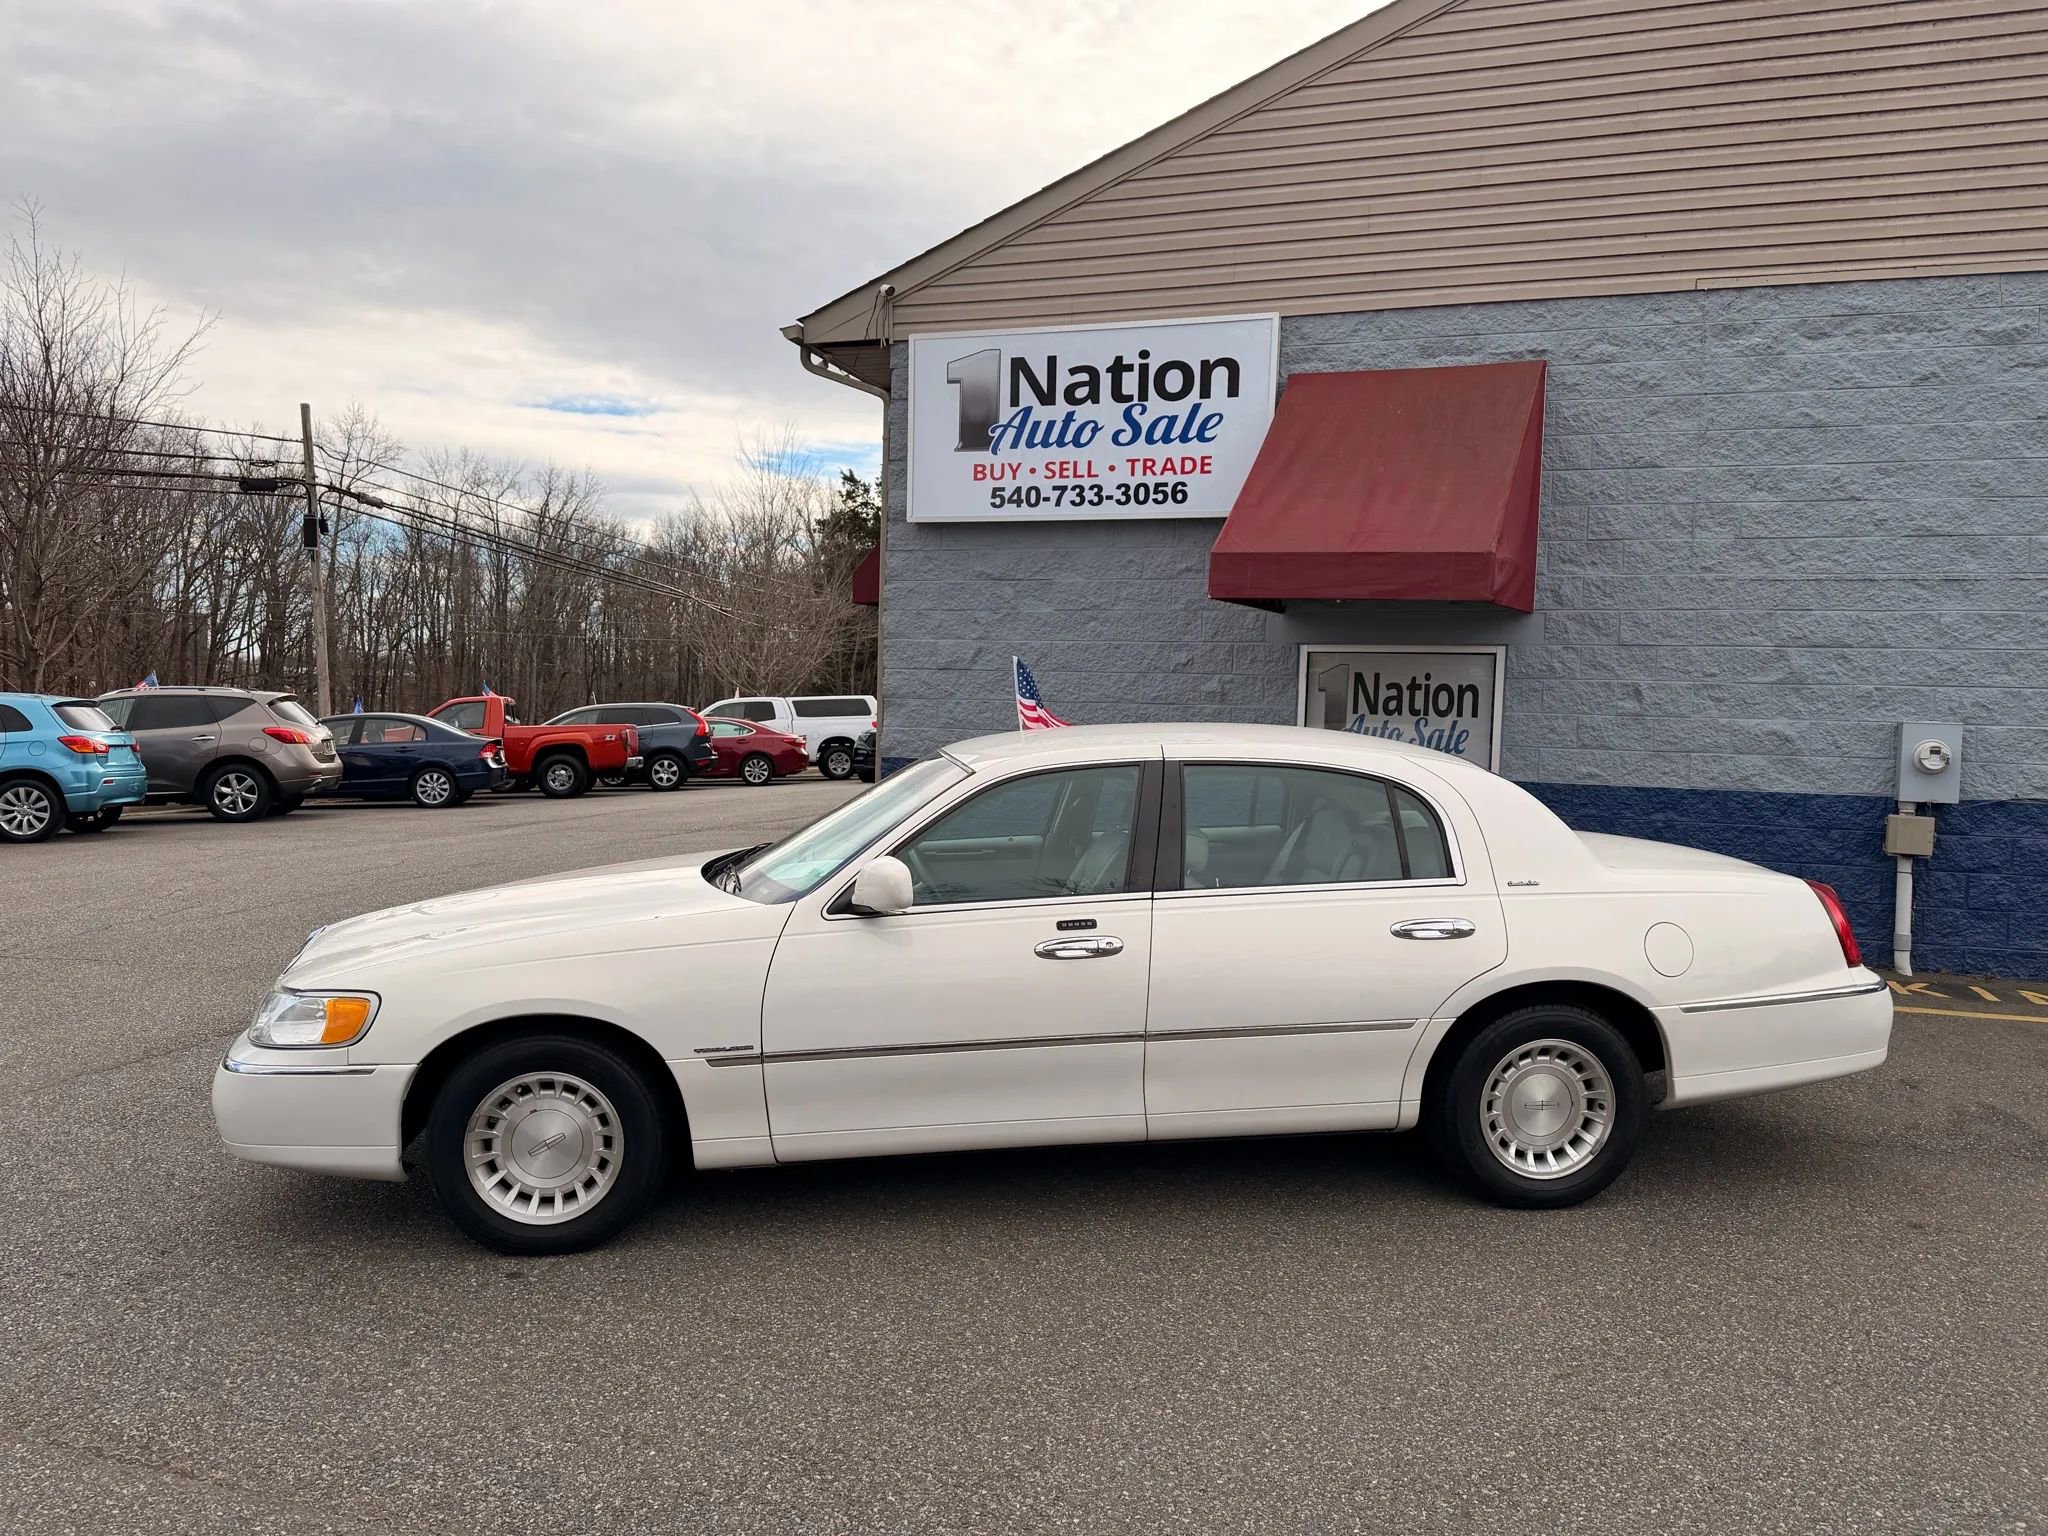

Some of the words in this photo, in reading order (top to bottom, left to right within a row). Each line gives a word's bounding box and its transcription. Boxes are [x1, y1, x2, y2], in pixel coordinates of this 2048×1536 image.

[947, 348, 1001, 452] 1
[1009, 349, 1241, 408] Nation
[988, 405, 1104, 455] Auto
[1111, 402, 1224, 447] Sale
[973, 462, 1022, 481] BUY
[1044, 459, 1099, 480] SELL
[1126, 455, 1213, 478] TRADE
[990, 481, 1189, 509] 540-733-3056
[1318, 663, 1349, 731] 1
[1352, 672, 1479, 718] Nation
[1408, 717, 1470, 755] Sale
